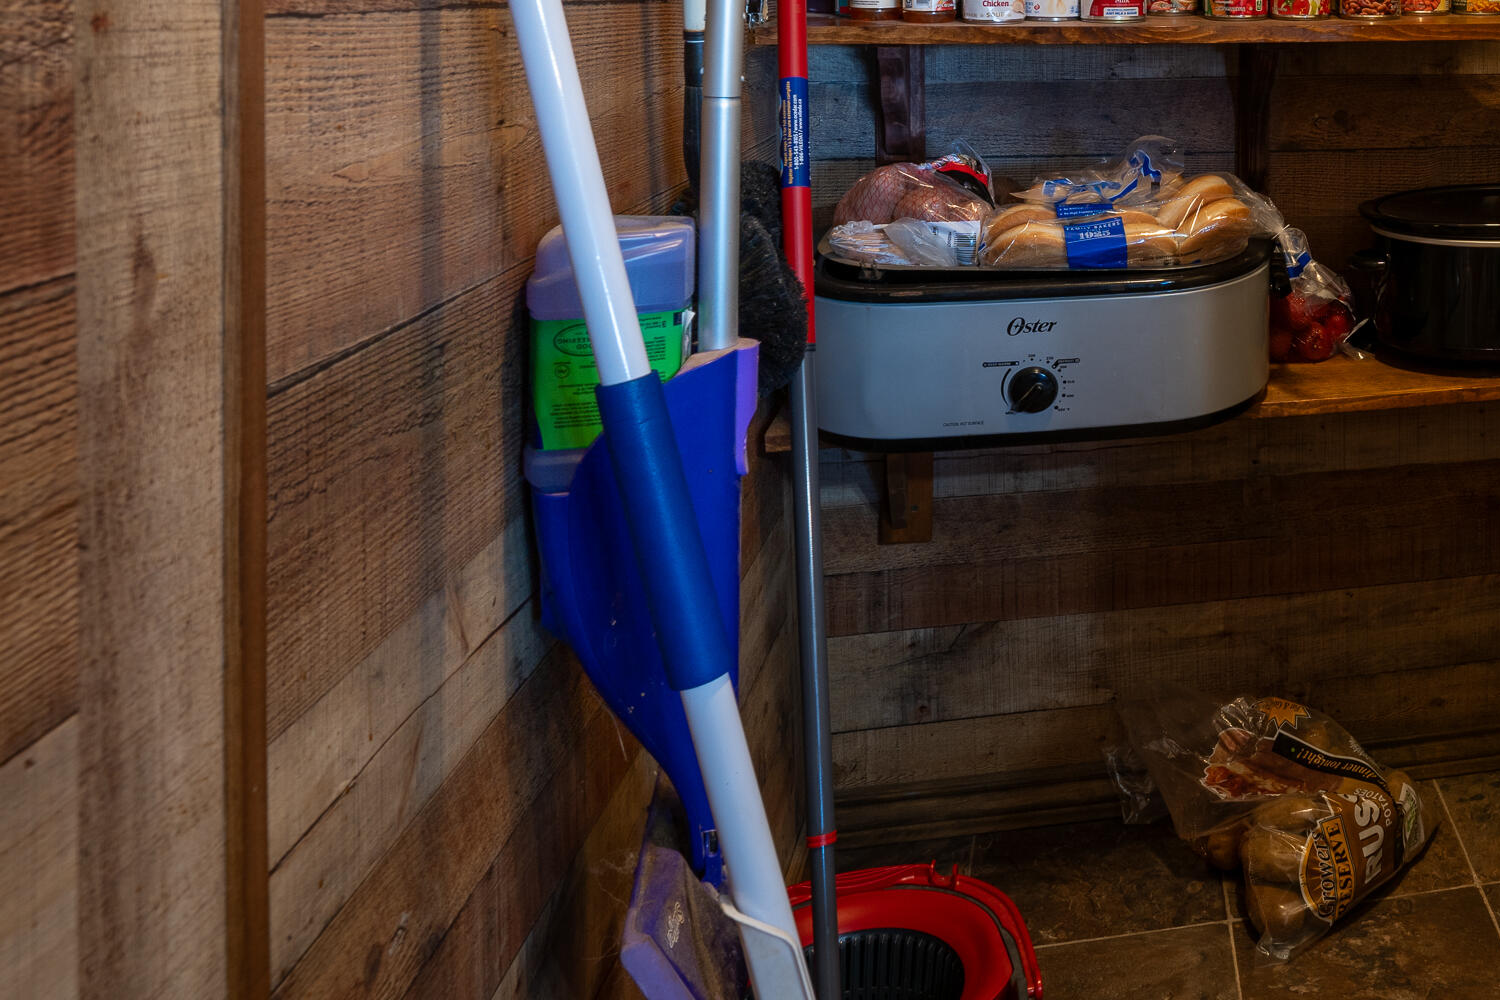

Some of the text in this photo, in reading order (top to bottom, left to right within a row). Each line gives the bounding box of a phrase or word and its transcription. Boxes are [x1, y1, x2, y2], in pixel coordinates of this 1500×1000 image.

[982, 0, 1010, 8] Chicken
[1007, 316, 1059, 337] Oster
[1296, 748, 1341, 770] tonight!
